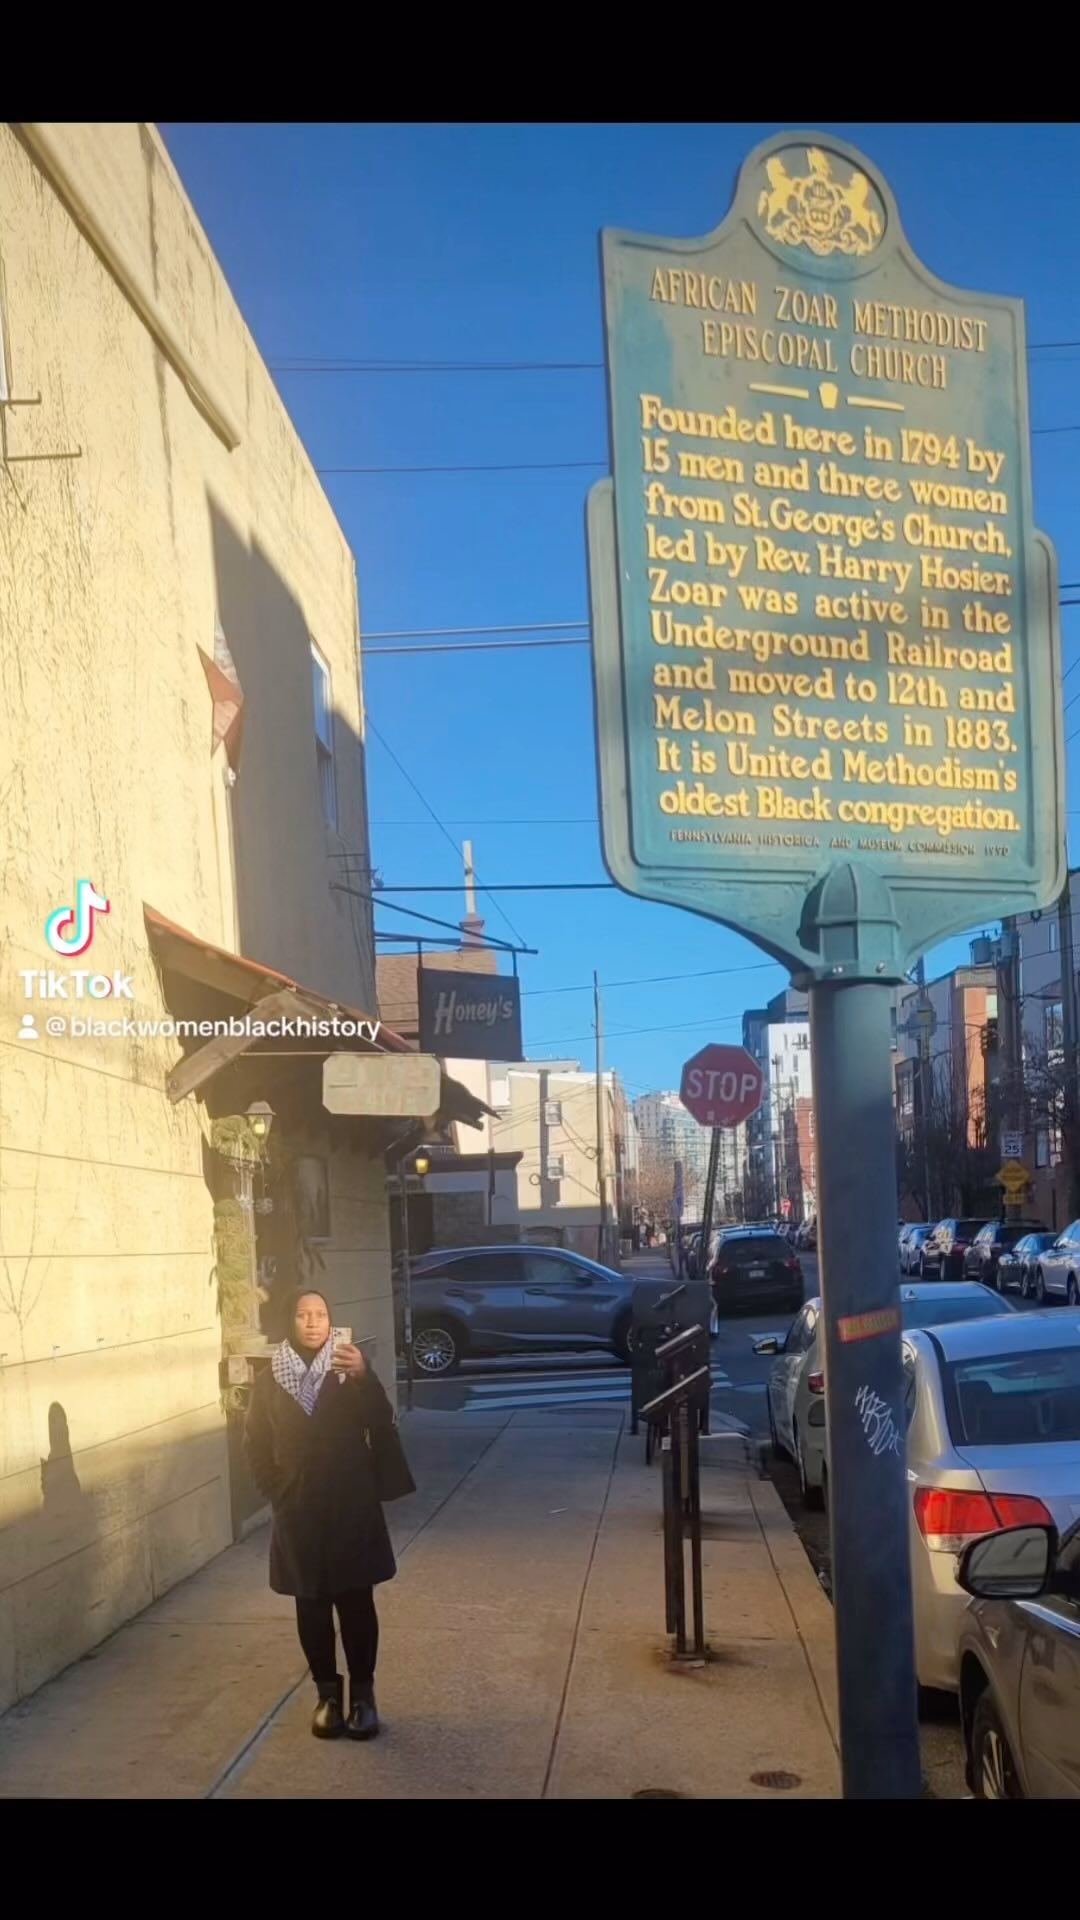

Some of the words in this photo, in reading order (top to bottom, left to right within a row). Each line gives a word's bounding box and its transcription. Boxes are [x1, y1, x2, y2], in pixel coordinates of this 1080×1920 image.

[651, 266, 757, 316] AFRICAN
[774, 285, 838, 329] ZOAR
[853, 301, 987, 352] METHODIST
[702, 319, 838, 373] EPISCOPAL
[850, 343, 947, 389] CHURCH
[640, 393, 777, 446] Founded
[783, 414, 857, 456] here
[864, 425, 893, 461] in
[901, 428, 961, 470] 1794
[966, 438, 1005, 485] by
[641, 435, 671, 473] 15
[678, 451, 745, 484] men
[754, 458, 810, 491] and
[817, 461, 902, 502] three
[909, 479, 1008, 515] women
[644, 481, 725, 524] from
[902, 513, 1012, 559] Church,
[645, 523, 697, 563] led
[704, 531, 749, 578] by
[754, 534, 812, 575] Rev.
[817, 541, 913, 594] Harry
[648, 567, 728, 607] Zoar
[738, 584, 799, 615] was
[814, 588, 909, 625] active
[921, 597, 950, 630] in
[962, 602, 1012, 635] the
[651, 609, 871, 663] Underground
[885, 630, 1014, 674] Railroad
[653, 657, 717, 691] and
[727, 667, 835, 700] moved
[844, 672, 878, 703] to
[887, 671, 949, 709] 12th
[959, 681, 1016, 713] and
[653, 694, 757, 737] Melon
[772, 703, 889, 744] Streets
[903, 713, 934, 747] in
[945, 715, 1018, 753] 1883.
[656, 737, 683, 772] It
[690, 740, 717, 775] is
[724, 740, 833, 781] United
[842, 748, 1017, 793] Methodism's
[658, 780, 751, 818] oldest
[755, 785, 834, 822] Black
[837, 798, 1021, 836] congregation.
[758, 833, 819, 848] HISTORICA
[433, 990, 514, 1035] Honey's
[685, 1068, 760, 1104] STOP
